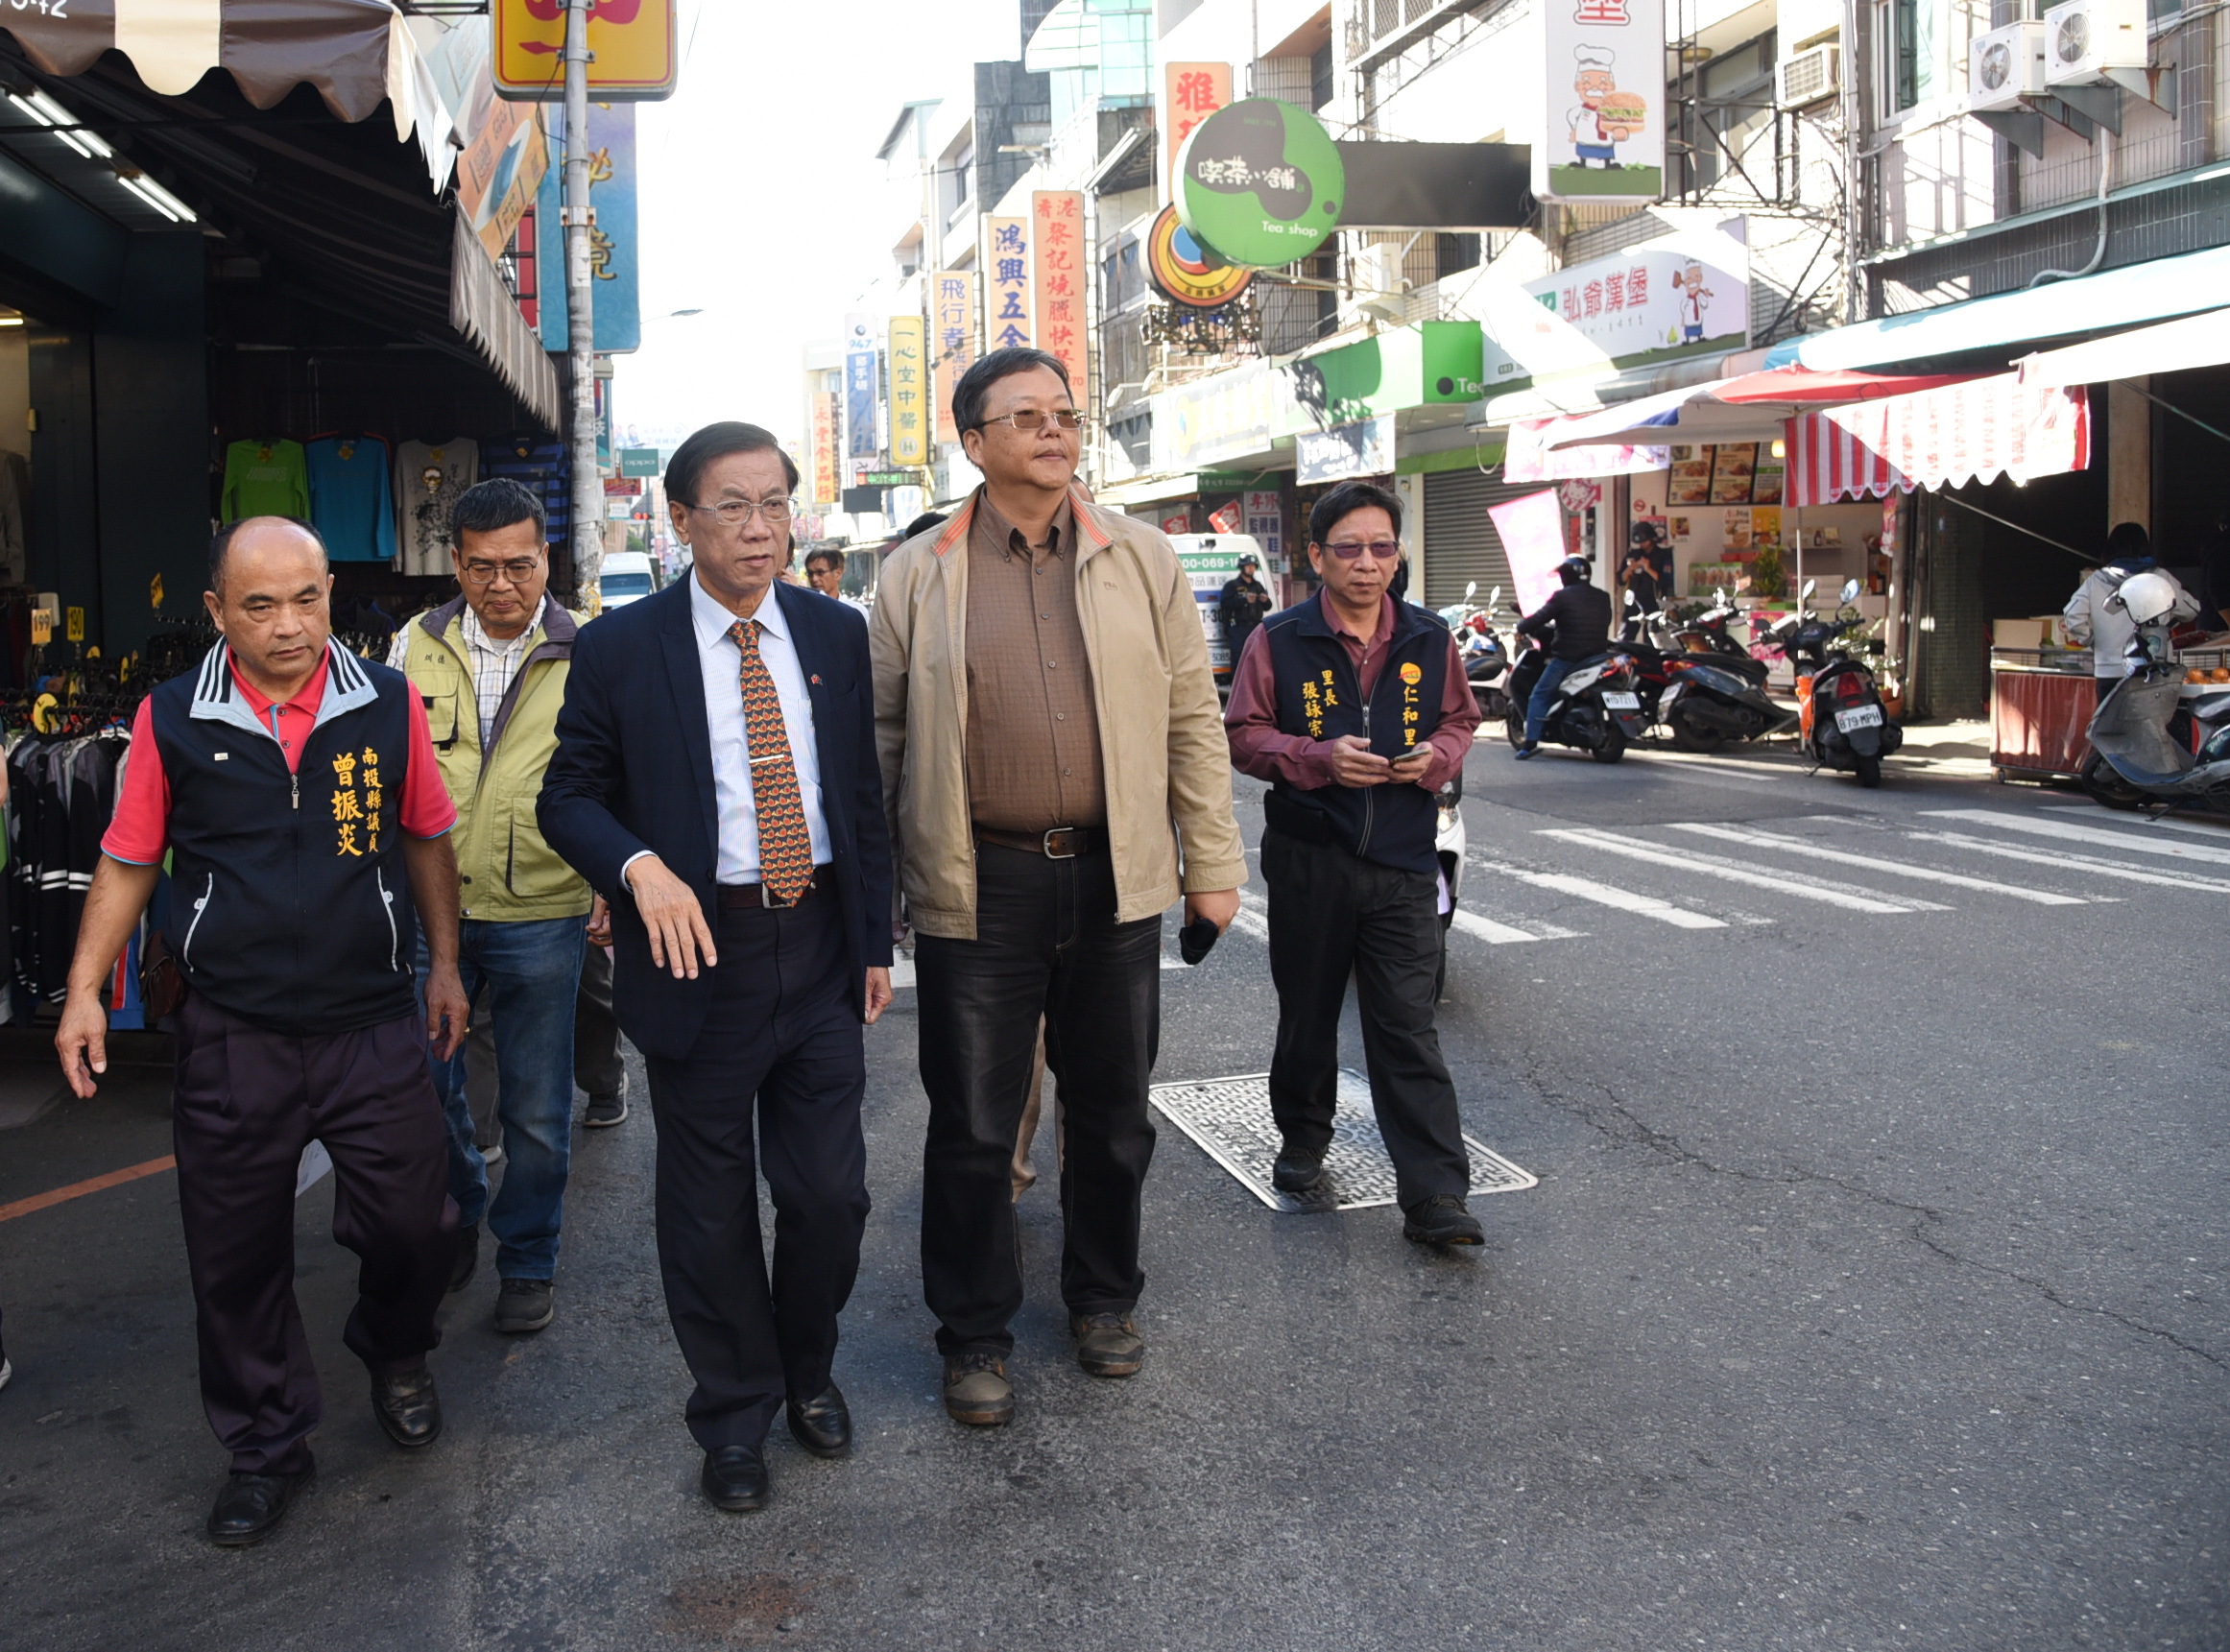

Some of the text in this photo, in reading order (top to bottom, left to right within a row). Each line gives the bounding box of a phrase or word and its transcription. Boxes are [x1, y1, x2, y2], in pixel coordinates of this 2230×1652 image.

[1261, 221, 1319, 238] Tea shop
[1562, 265, 1650, 324] 弘爺漢堡
[895, 329, 919, 430] 一心堂中醫
[1302, 681, 1324, 737] 張詠宗
[1321, 669, 1339, 707] 里長
[1403, 685, 1419, 746] 仁和里
[330, 752, 365, 857] 曾振炎
[362, 746, 383, 853] 南投縣議員
